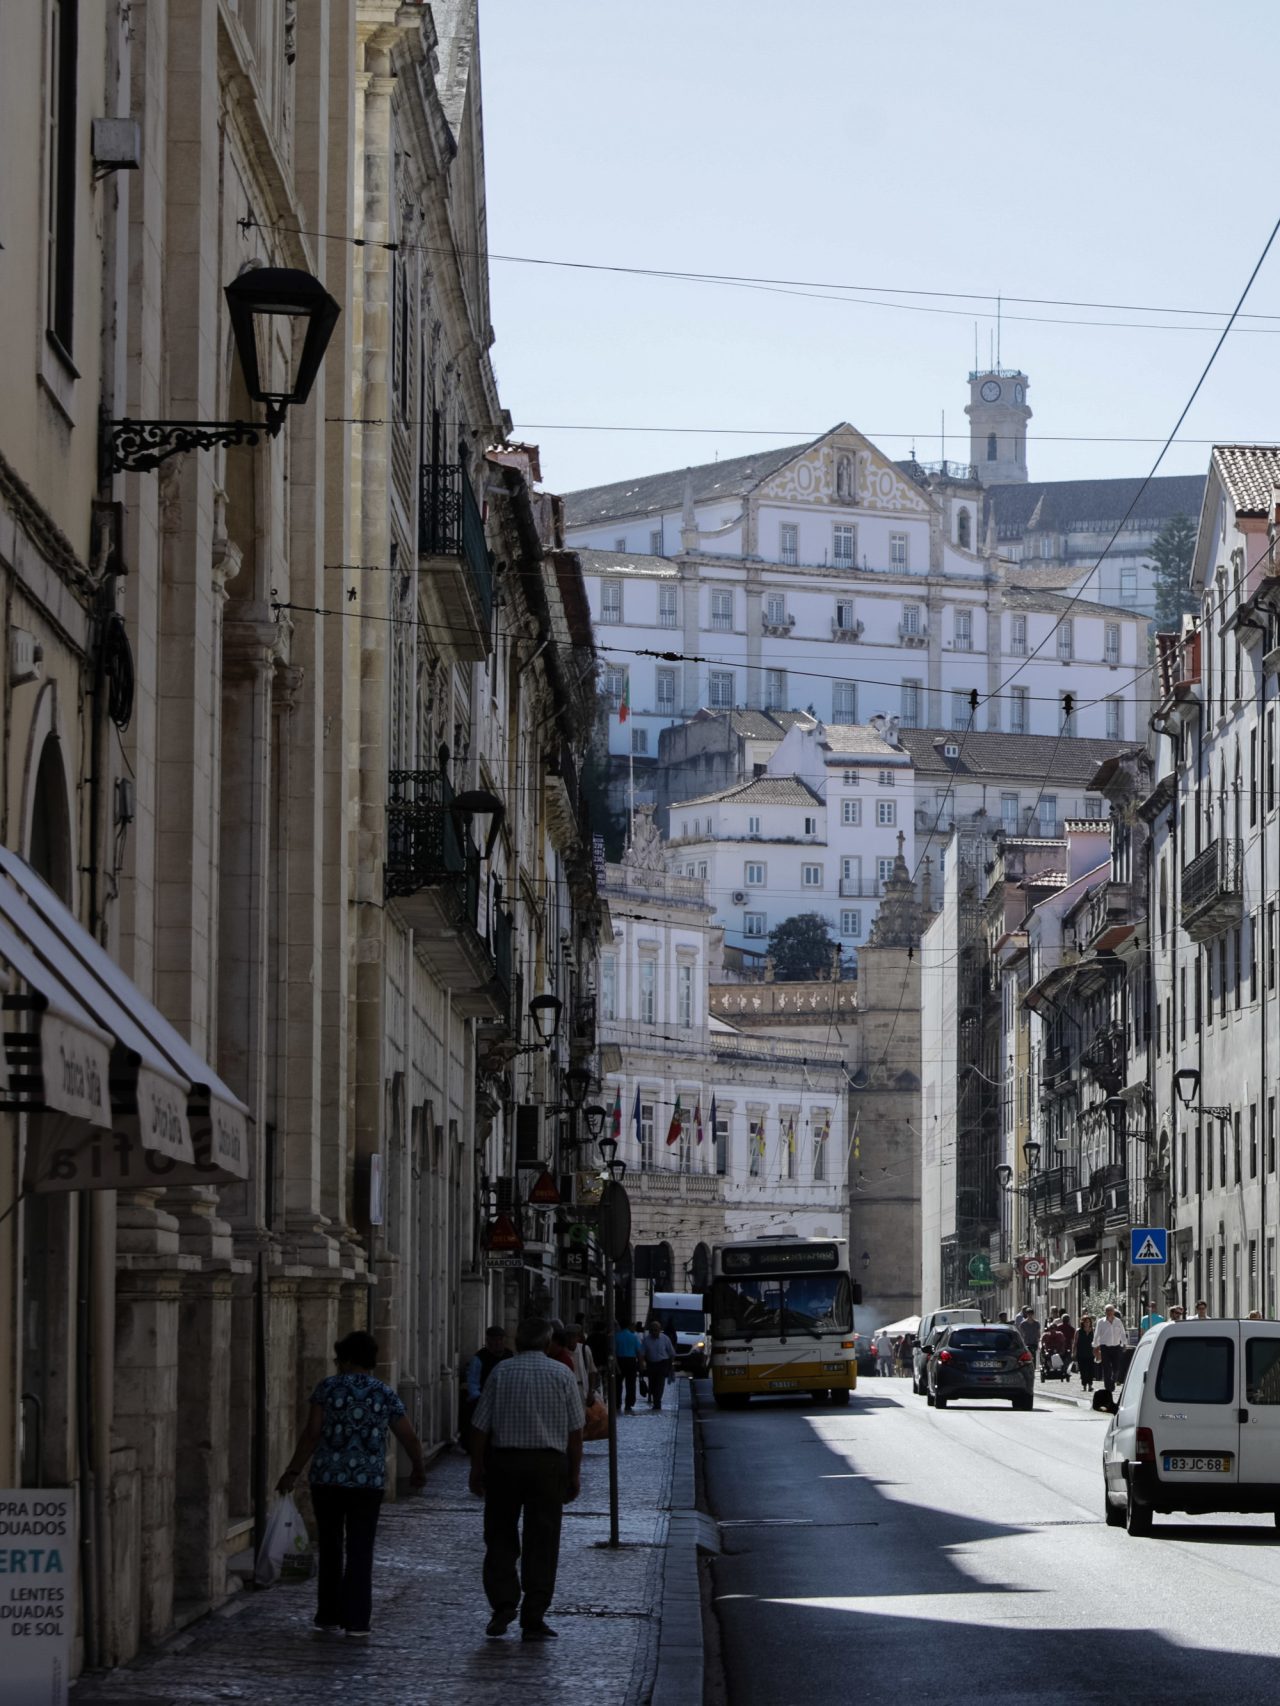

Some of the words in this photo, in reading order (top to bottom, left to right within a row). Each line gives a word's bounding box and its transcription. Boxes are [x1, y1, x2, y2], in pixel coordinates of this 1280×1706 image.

[33, 1502, 67, 1517] DOS
[0, 1521, 67, 1536] DUADOS
[0, 1549, 64, 1573] ERTA
[10, 1587, 64, 1601] LENTES
[0, 1605, 64, 1618] DUADAS
[11, 1622, 32, 1636] DE
[35, 1622, 64, 1636] SOL
